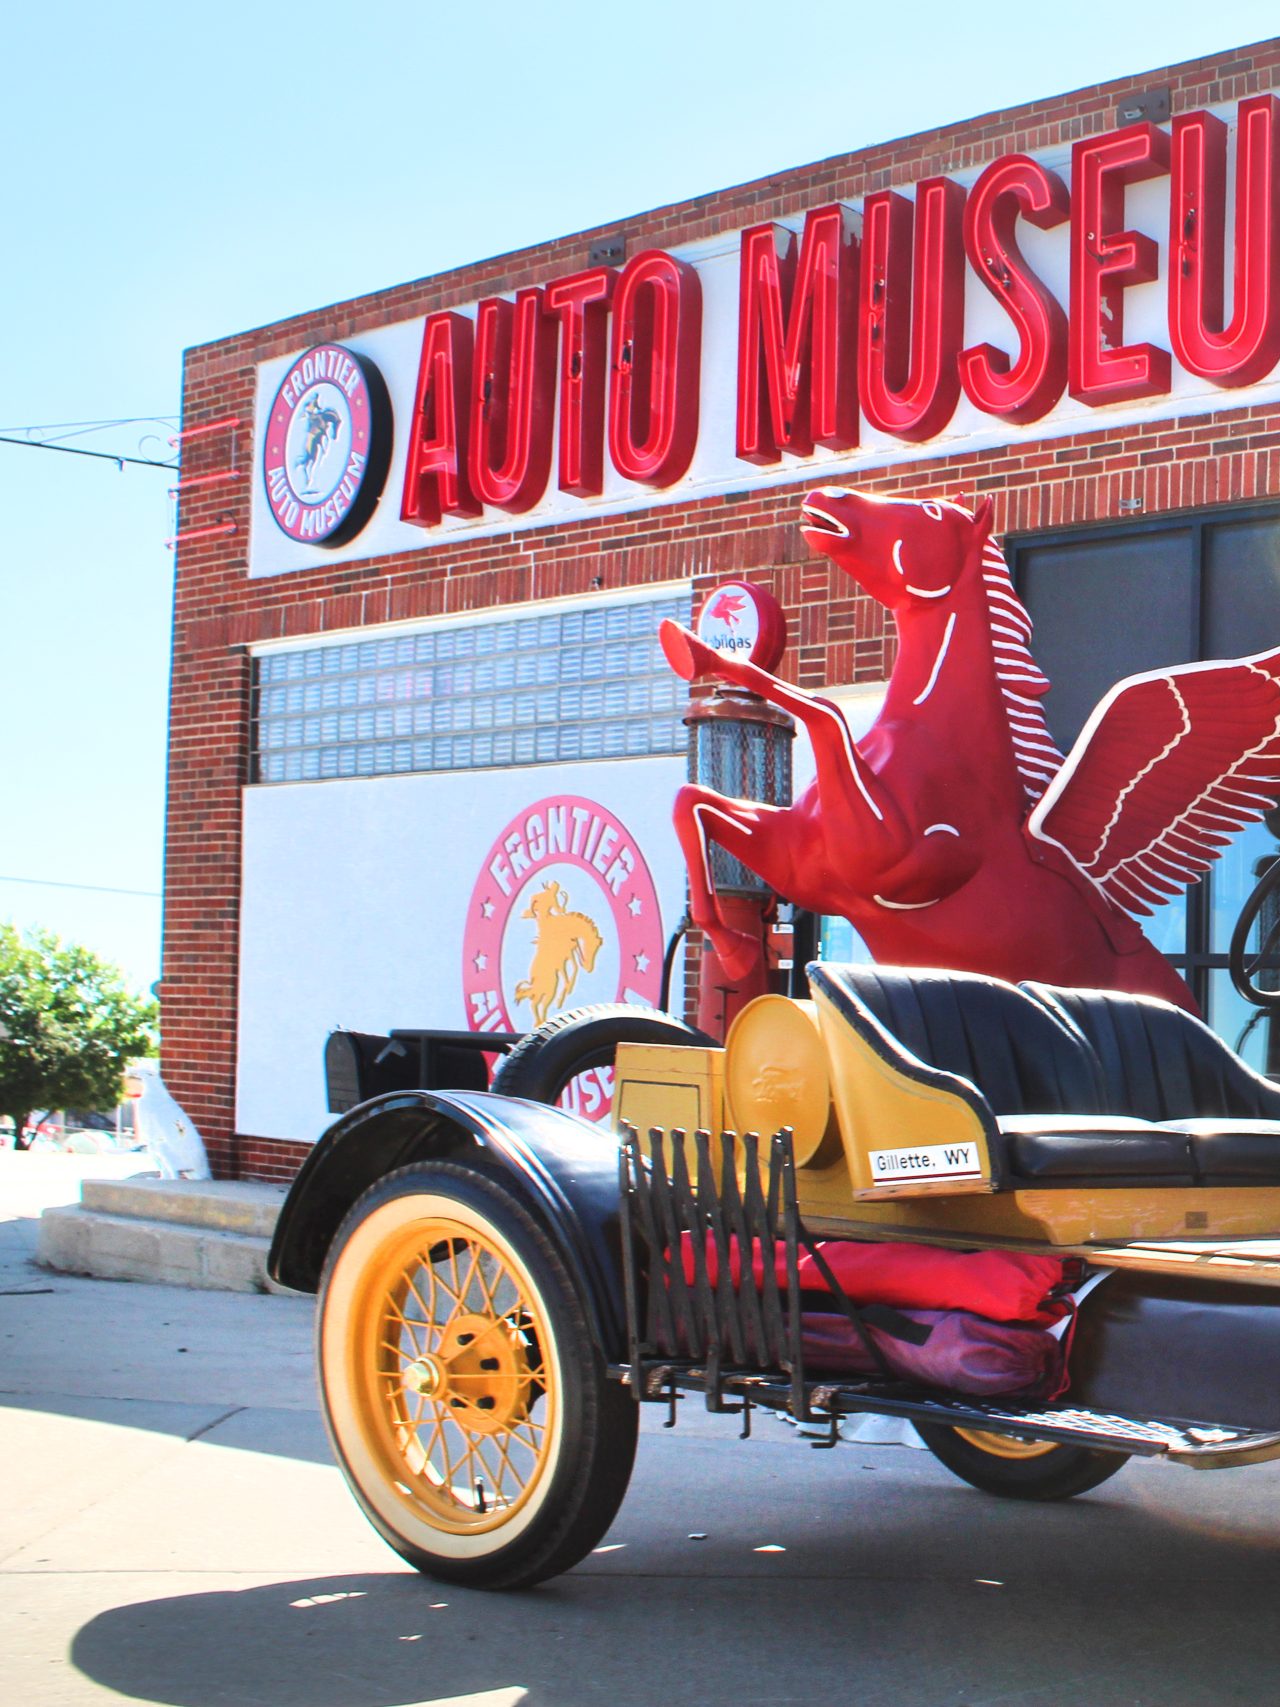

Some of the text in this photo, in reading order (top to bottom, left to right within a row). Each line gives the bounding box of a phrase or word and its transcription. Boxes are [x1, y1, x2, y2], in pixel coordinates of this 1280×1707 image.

[282, 350, 360, 409] FRONTIER
[400, 248, 700, 527] AUTO
[268, 451, 366, 537] AUTO MUSEUM
[488, 806, 635, 897] FRONTIER
[877, 1148, 970, 1171] Gillette, WY
